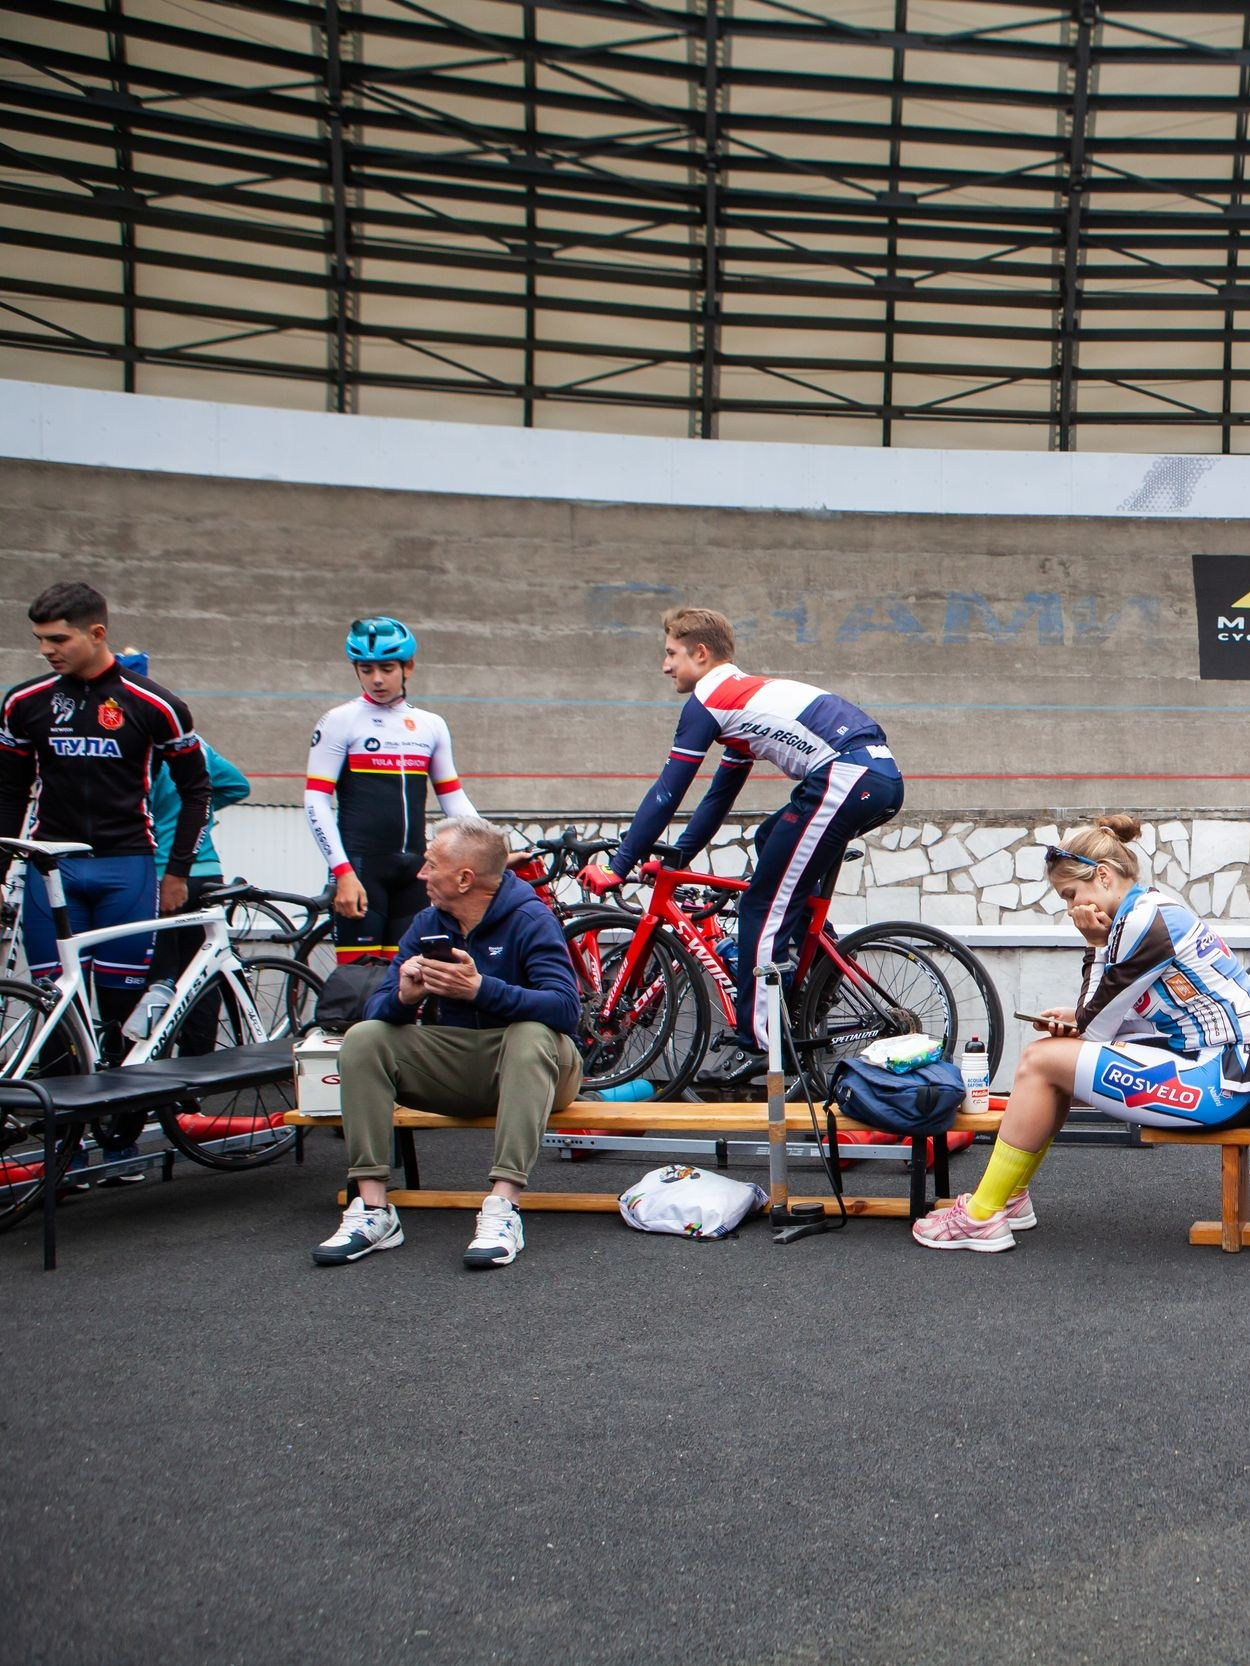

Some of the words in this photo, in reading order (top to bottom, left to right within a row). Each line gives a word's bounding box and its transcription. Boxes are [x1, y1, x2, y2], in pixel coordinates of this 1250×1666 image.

[49, 736, 123, 758] ТУЛА
[740, 722, 771, 737] TULA
[770, 730, 817, 756] REGION
[371, 758, 393, 766] TULA
[395, 758, 426, 768] REGION
[314, 826, 333, 856] REGION
[147, 965, 208, 1063] ONDRIEST
[831, 1029, 880, 1045] SPECIALIZED
[1108, 1068, 1195, 1104] ROSVELO
